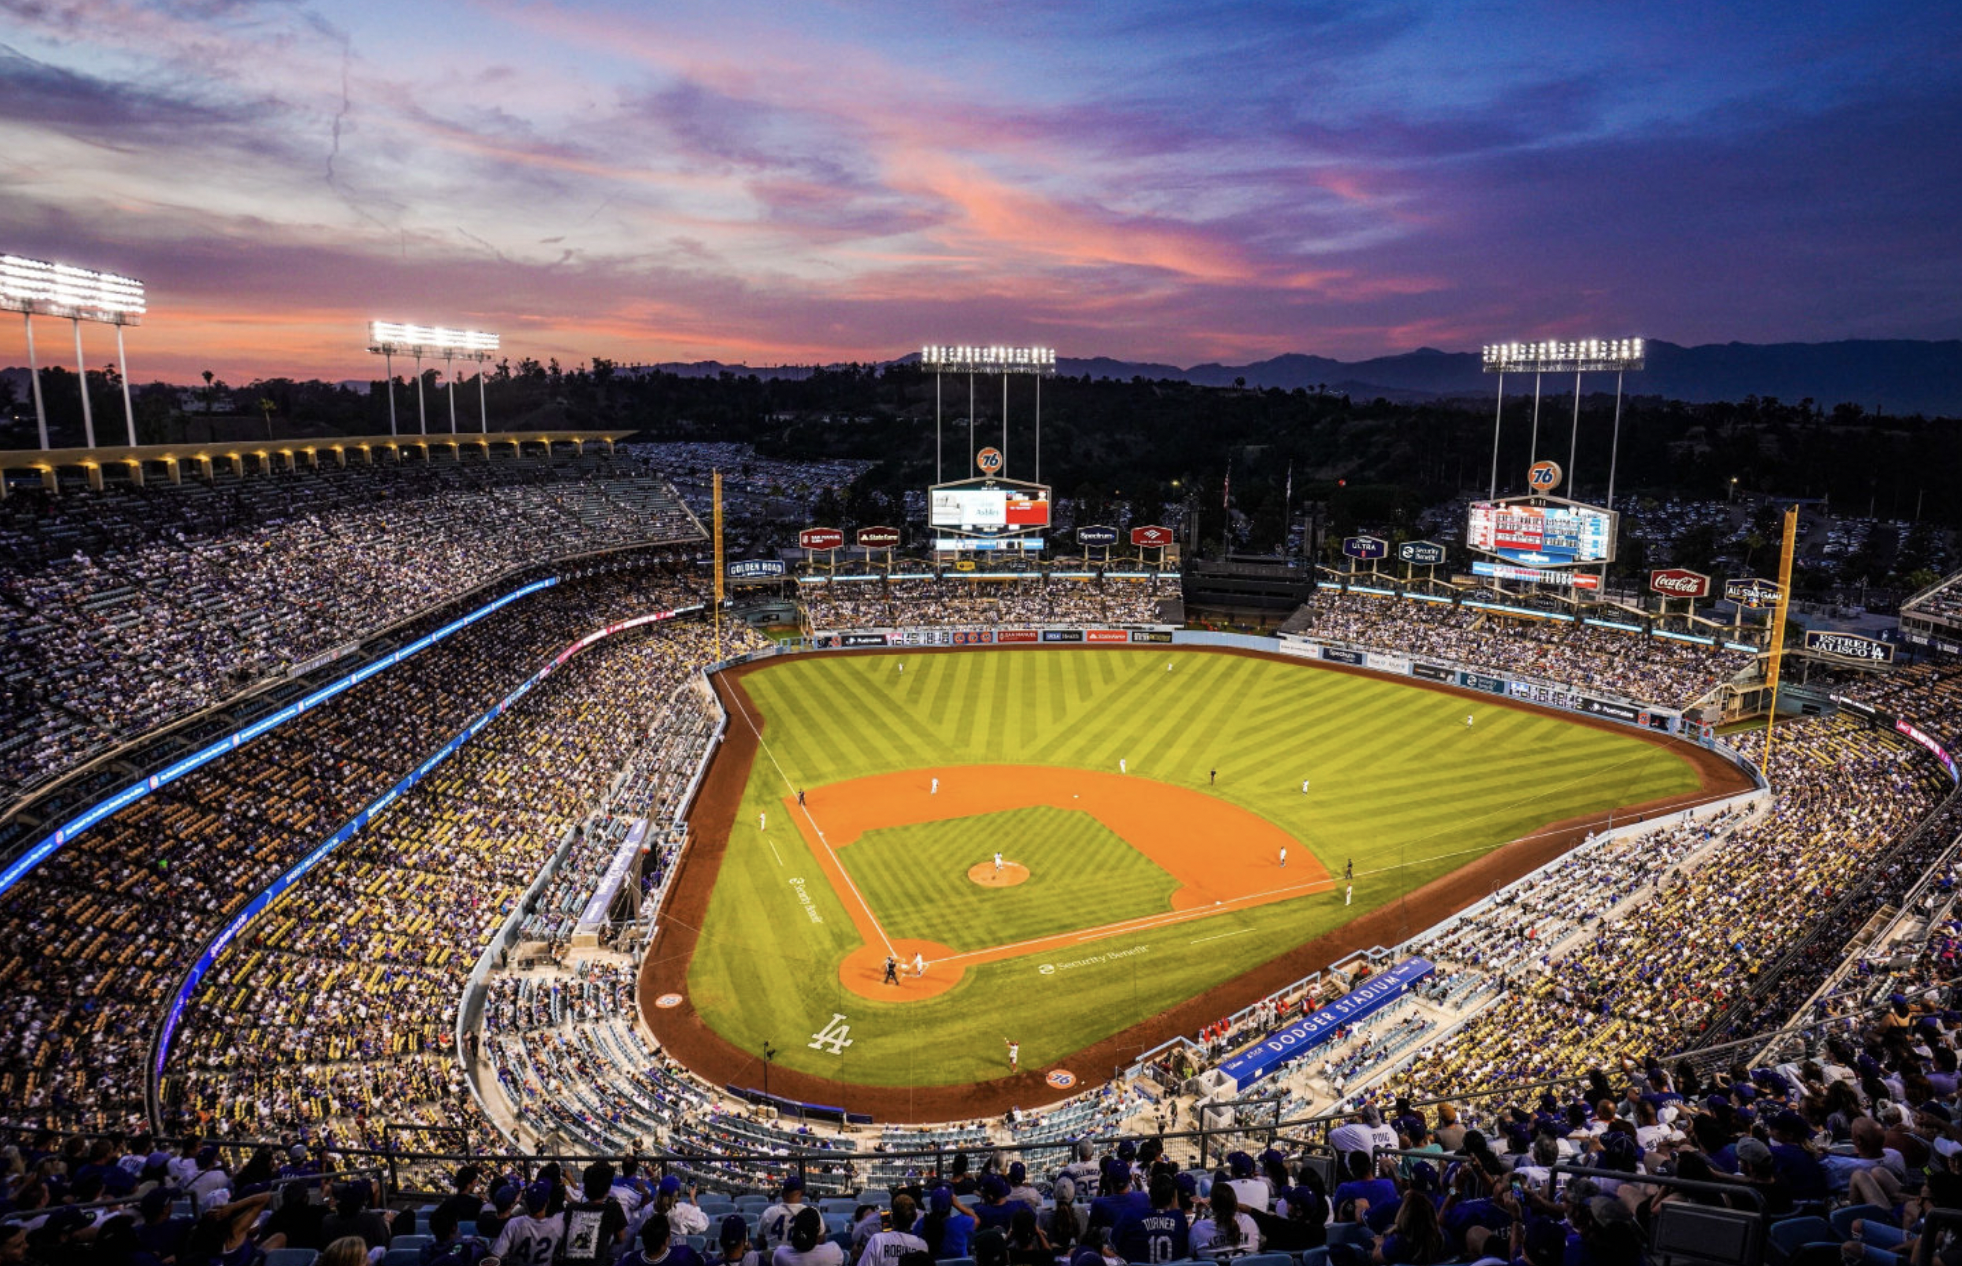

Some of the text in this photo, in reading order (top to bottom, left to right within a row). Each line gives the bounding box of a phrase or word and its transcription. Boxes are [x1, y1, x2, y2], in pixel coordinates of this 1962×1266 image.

[983, 453, 999, 467] 76
[1532, 468, 1554, 484] 76
[1352, 543, 1376, 551] ULTRA
[1415, 547, 1439, 555] Security
[731, 561, 782, 575] GOLDEN ROAD
[1812, 641, 1868, 657] JALISCO
[1057, 944, 1150, 971] Security Benefit
[1268, 975, 1401, 1052] DODGER STADIUM
[807, 1013, 854, 1055] LA
[1052, 1074, 1070, 1085] 76
[1372, 1132, 1390, 1143] PUIG
[1076, 1178, 1099, 1196] 35
[1141, 1216, 1176, 1232] TURNER
[515, 1236, 552, 1264] 42
[1148, 1235, 1173, 1264] 10
